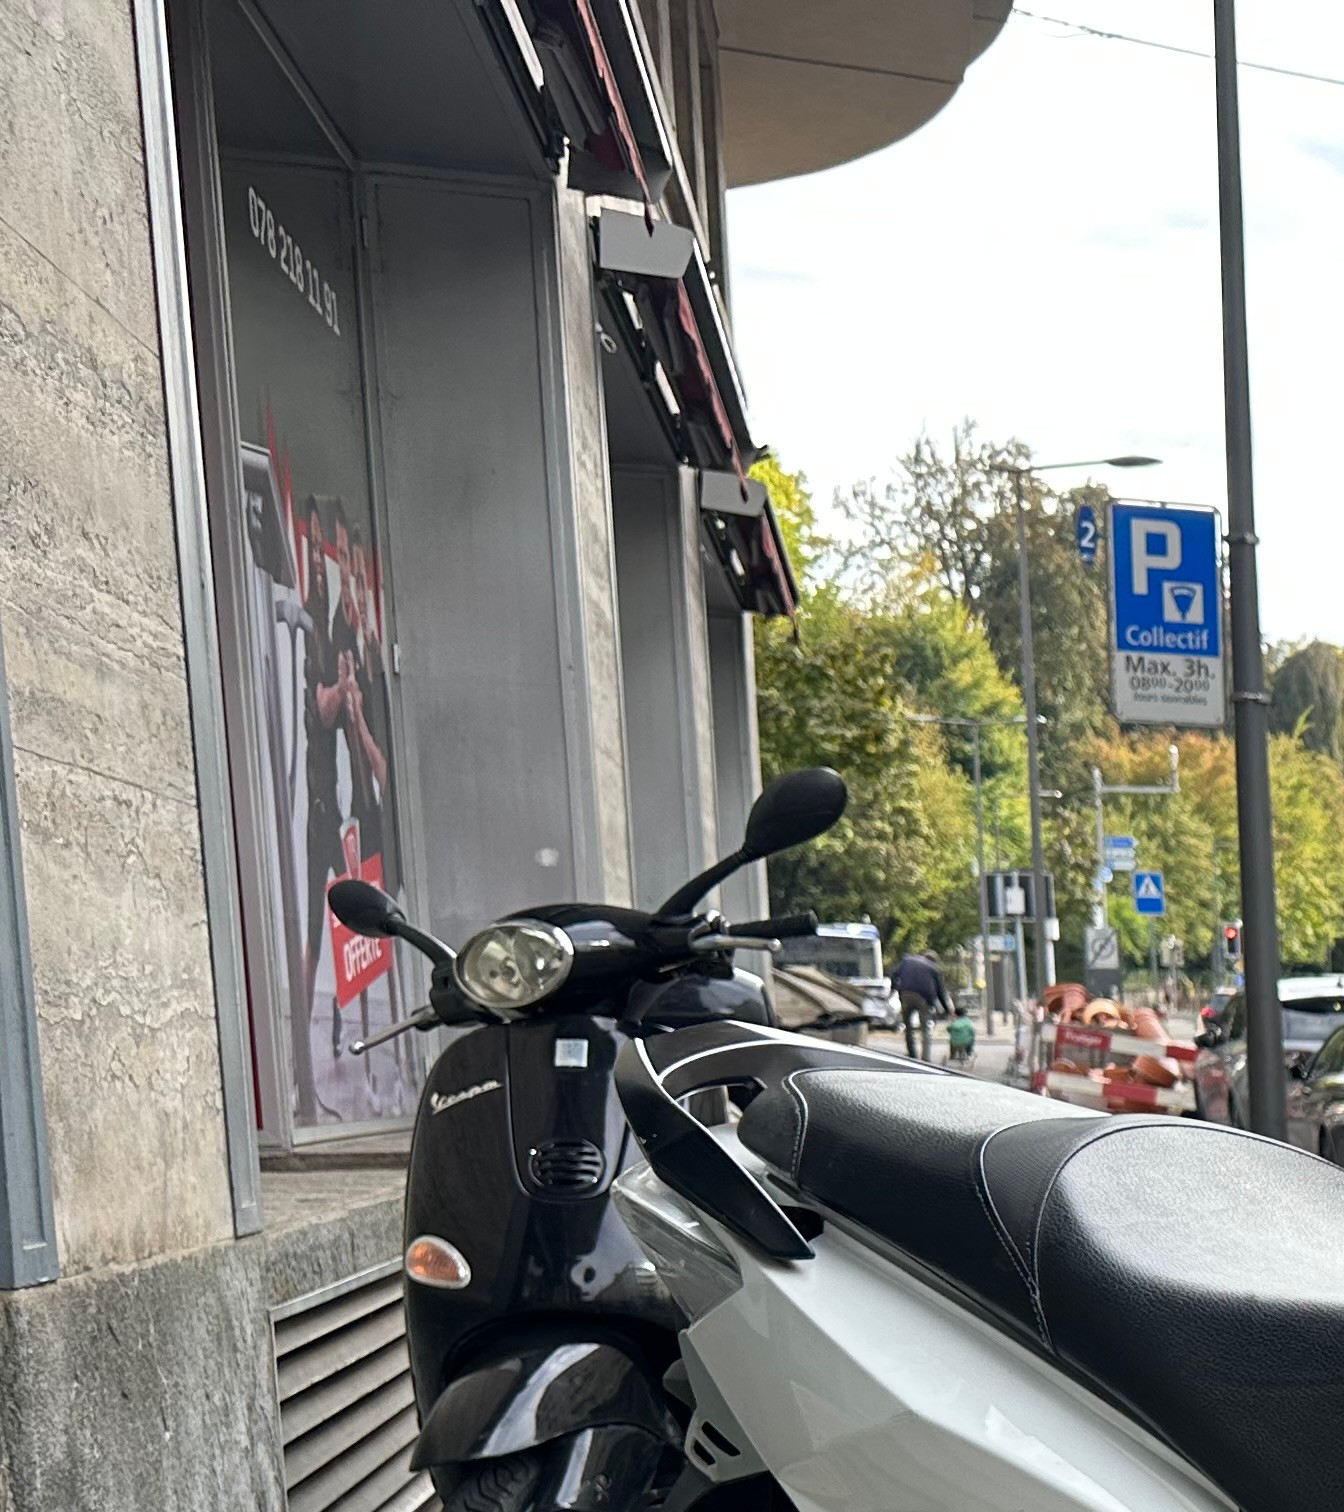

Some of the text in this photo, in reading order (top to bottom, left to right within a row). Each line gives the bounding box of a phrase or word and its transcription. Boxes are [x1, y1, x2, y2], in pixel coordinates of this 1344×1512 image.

[248, 186, 341, 337] 078 218 11 91
[1080, 520, 1096, 548] 2
[1130, 517, 1182, 595] P
[1125, 624, 1209, 651] Collectif
[1125, 654, 1177, 676] Max.
